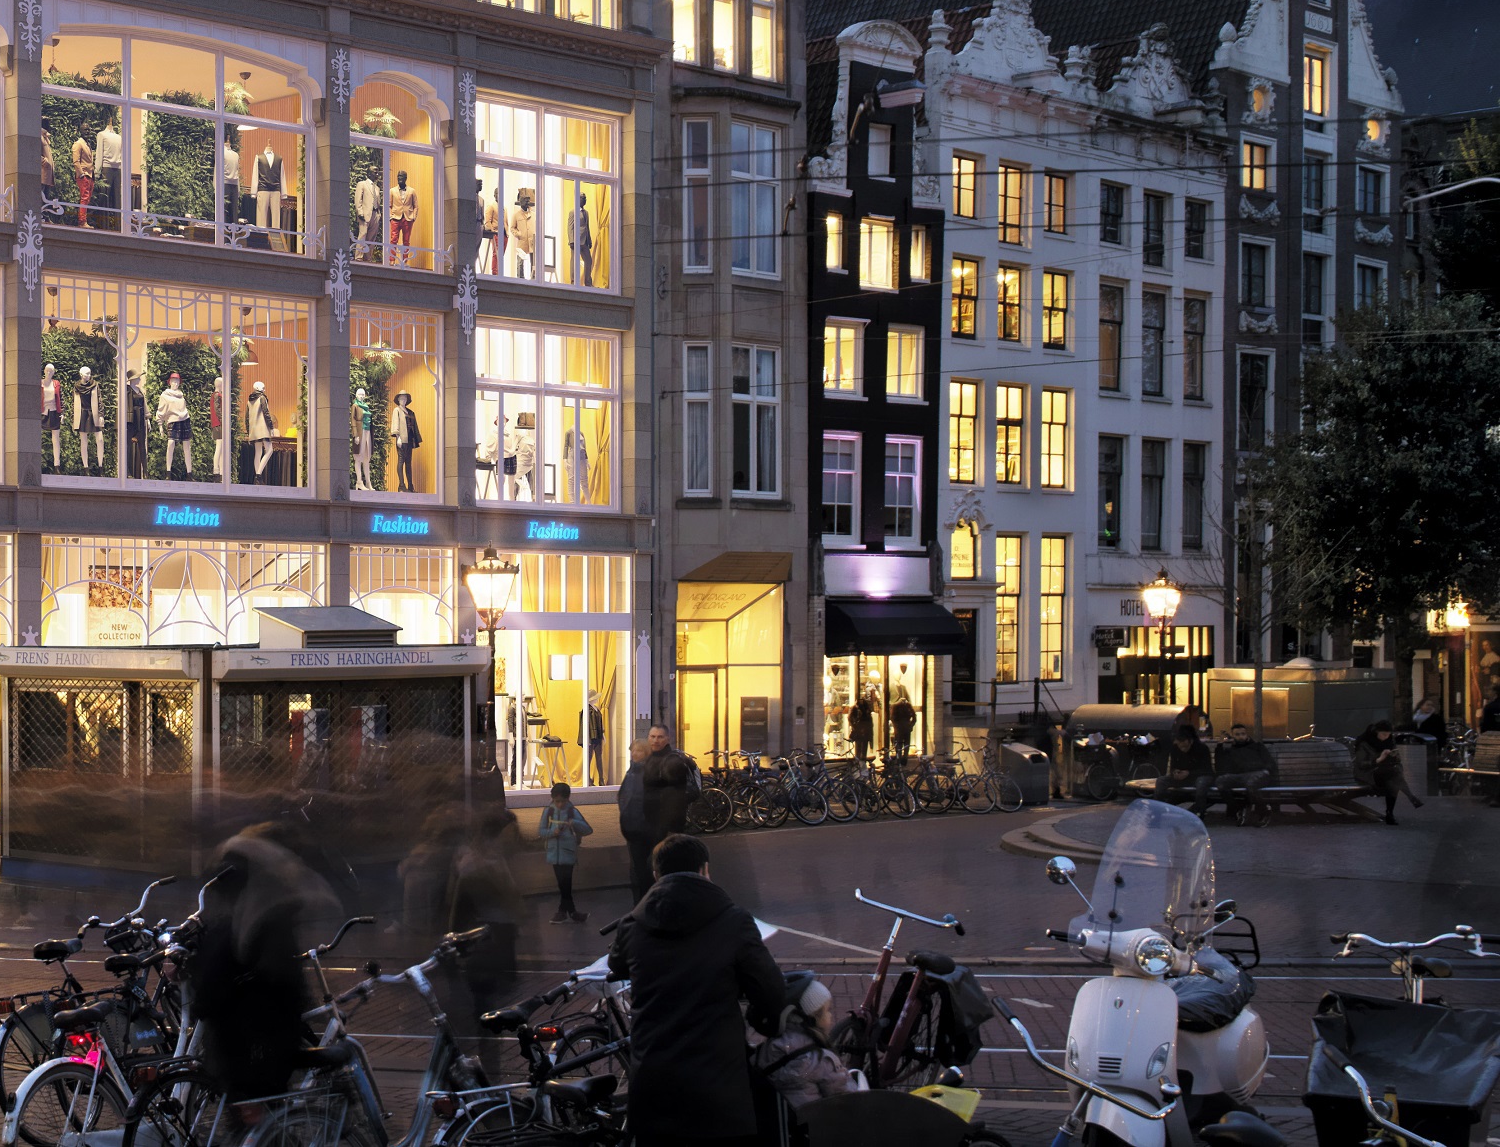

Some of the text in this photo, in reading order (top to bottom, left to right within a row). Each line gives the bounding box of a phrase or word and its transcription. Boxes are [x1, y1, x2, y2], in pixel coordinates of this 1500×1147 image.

[155, 506, 220, 527] Fashion
[372, 514, 428, 535] Fashion
[528, 521, 579, 540] Fashion
[1120, 599, 1145, 616] HOTEL
[111, 623, 128, 631] NEW
[98, 632, 141, 640] COLLECTION
[15, 651, 49, 665] FRENS
[290, 651, 433, 666] FRENS HARINGHANDEL
